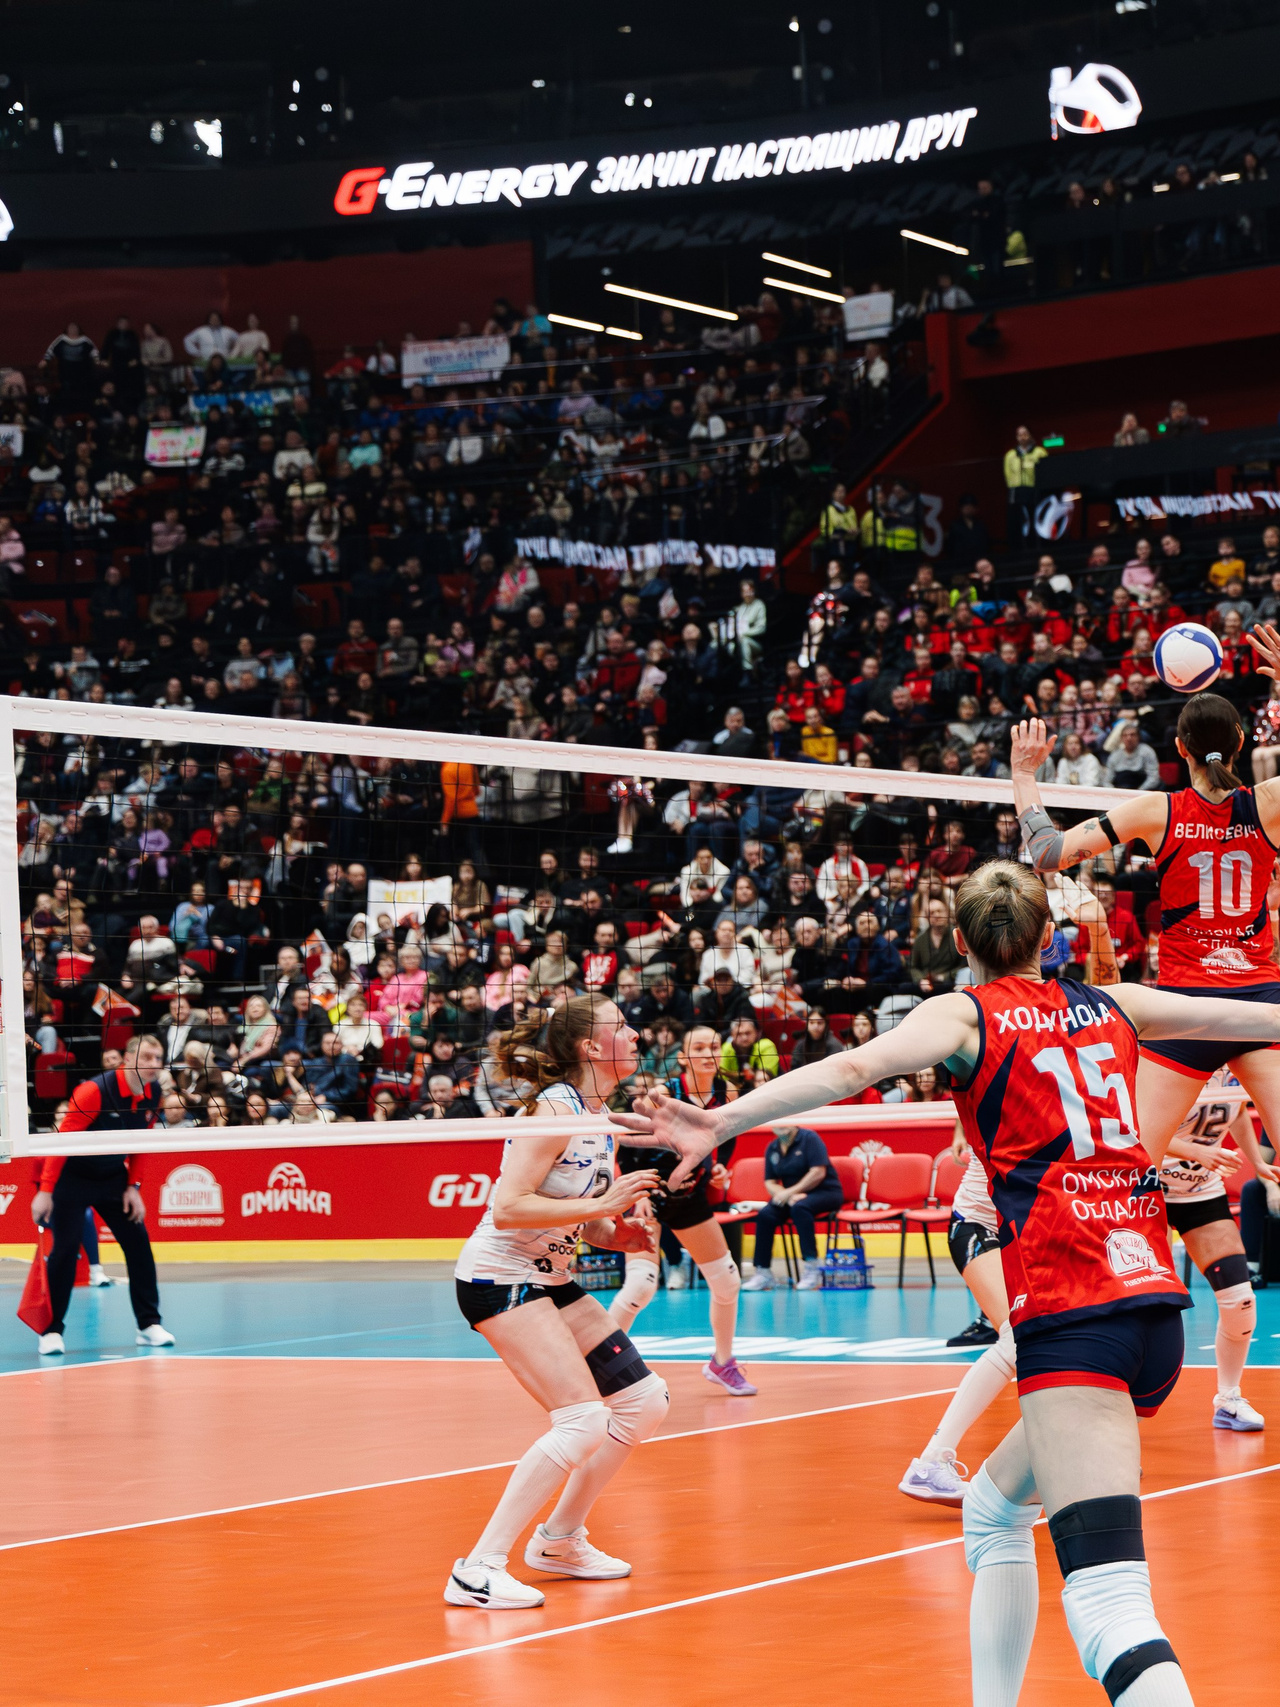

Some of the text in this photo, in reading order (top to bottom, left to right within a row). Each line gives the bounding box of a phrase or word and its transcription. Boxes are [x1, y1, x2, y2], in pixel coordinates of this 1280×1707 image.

[591, 147, 717, 194] ЗНАЧИТ
[712, 120, 901, 183] НАСТОЯЩИЙ
[895, 107, 978, 164] ДРУГ
[1187, 850, 1252, 919] 10
[1031, 1042, 1140, 1161] 15
[1191, 1103, 1232, 1138] 12
[241, 1188, 332, 1216] ОМИЧКА
[1062, 1165, 1159, 1194] ОМСКАЯ
